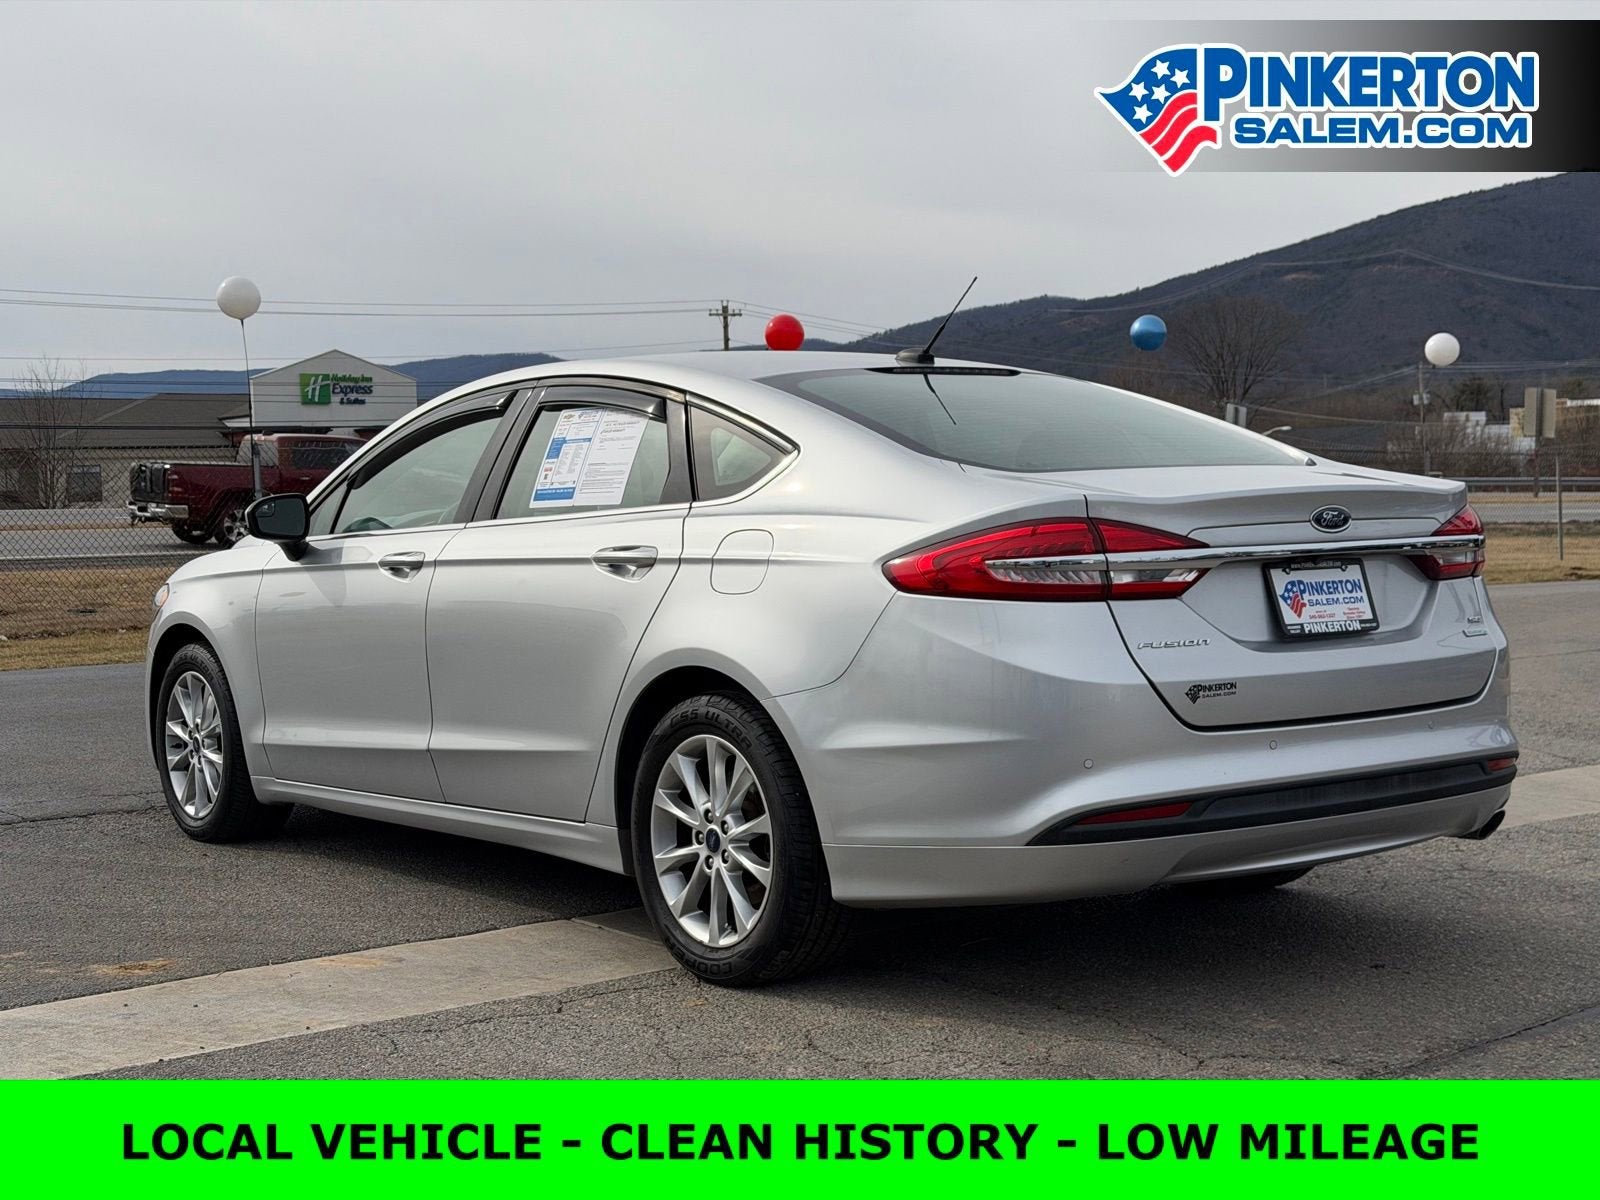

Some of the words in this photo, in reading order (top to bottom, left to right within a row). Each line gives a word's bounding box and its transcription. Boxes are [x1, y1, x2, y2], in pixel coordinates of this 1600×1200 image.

[332, 383, 373, 397] Express
[1297, 579, 1362, 600] PINKERTON
[1308, 596, 1364, 607] SALEM.COM
[1304, 620, 1361, 634] PINKERTON
[1197, 682, 1237, 694] PINKERTON
[704, 711, 752, 748] ULTRA
